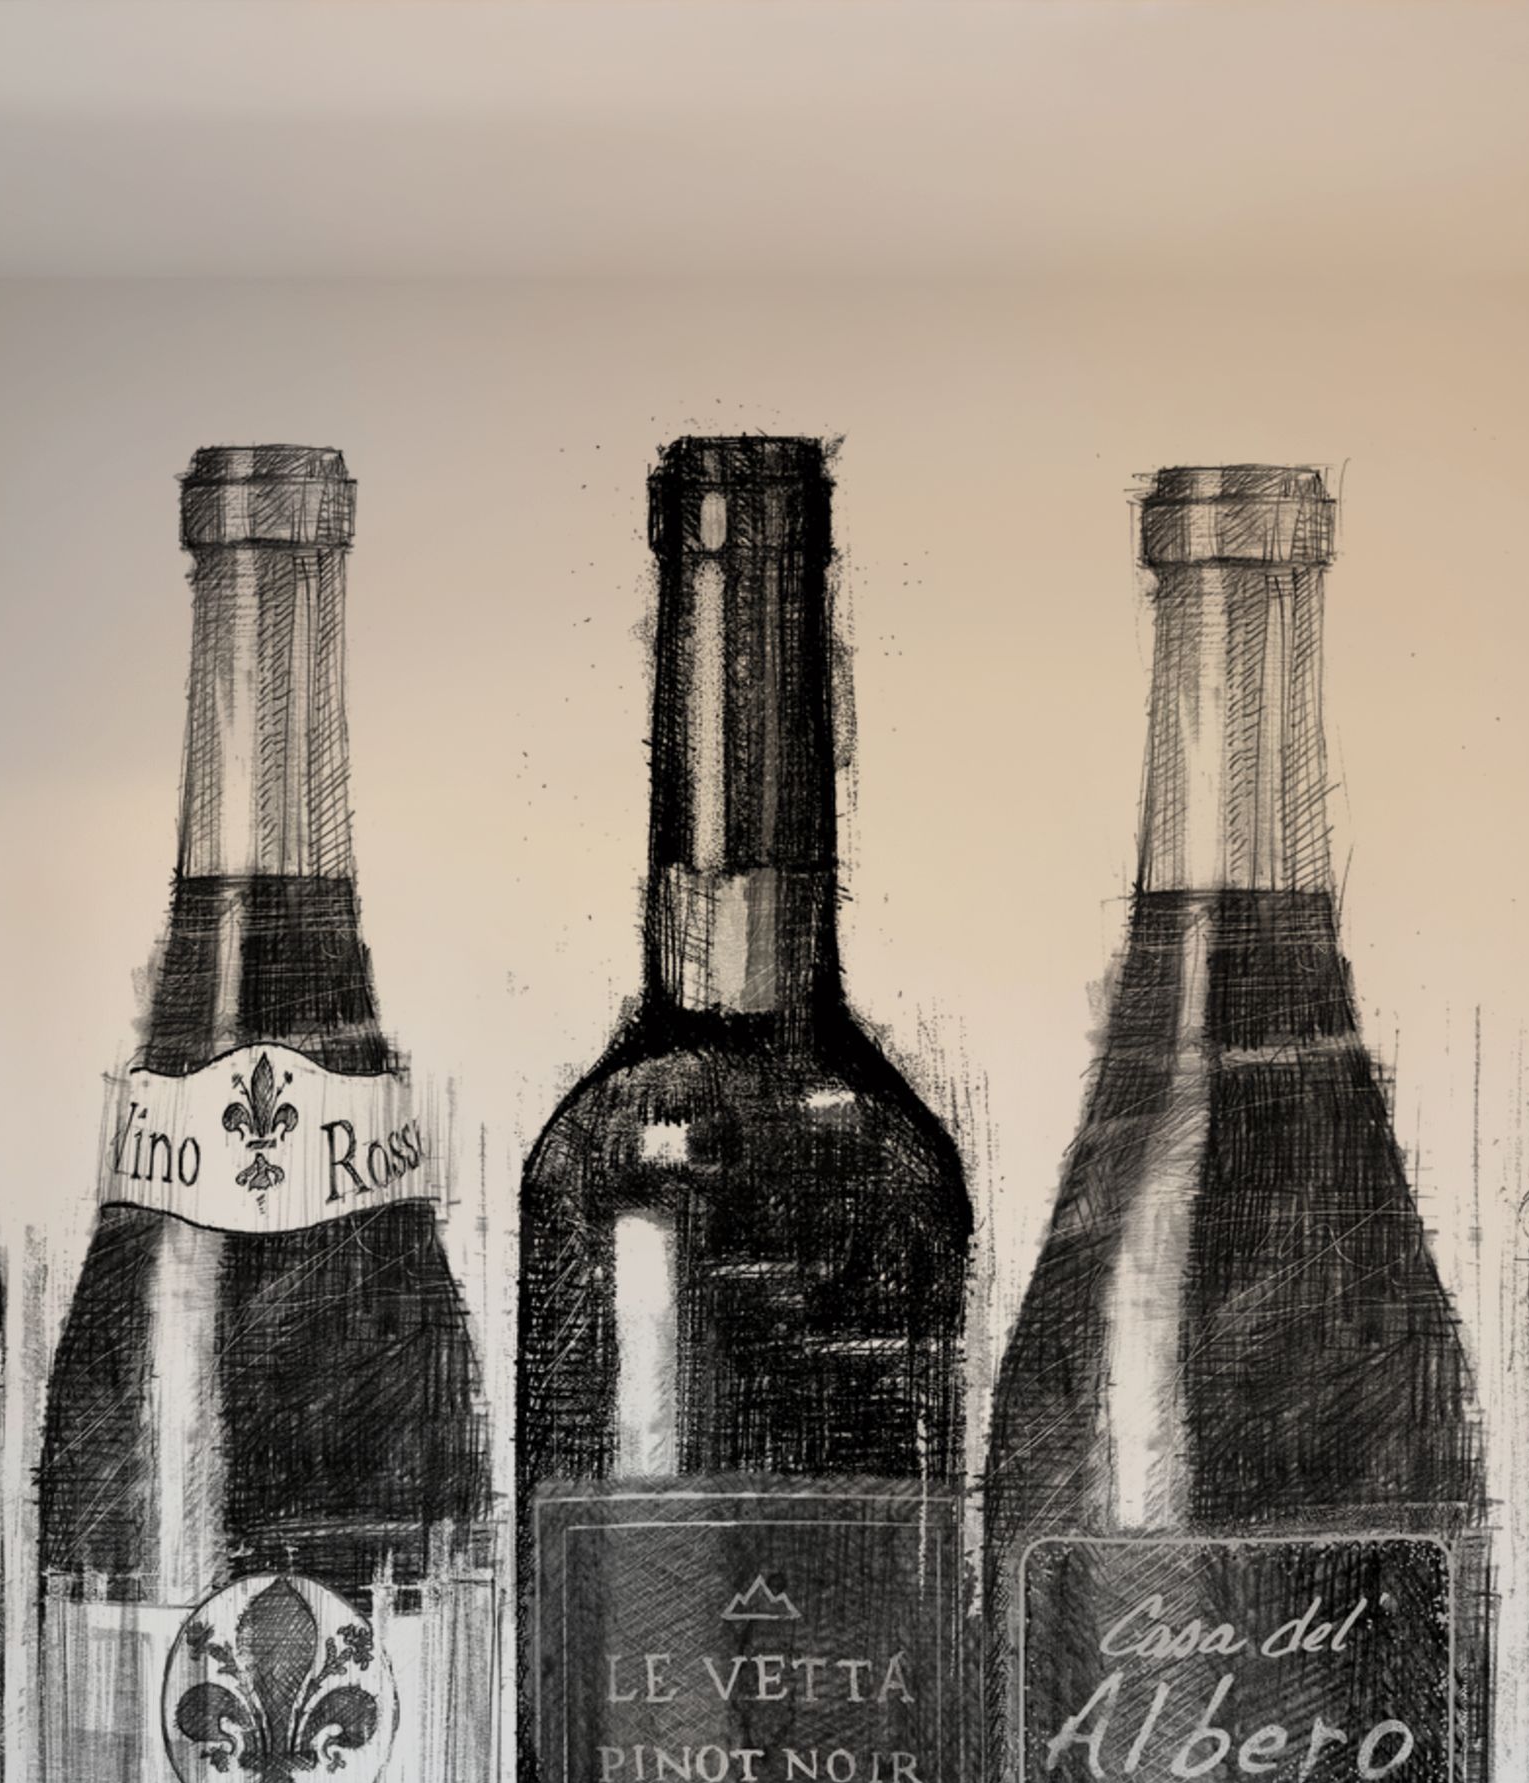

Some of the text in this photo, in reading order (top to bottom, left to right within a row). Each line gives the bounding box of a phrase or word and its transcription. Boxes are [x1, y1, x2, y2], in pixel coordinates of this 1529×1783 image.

[1099, 1593, 1248, 1658] Casa
[604, 1650, 914, 1703] LE VETTA
